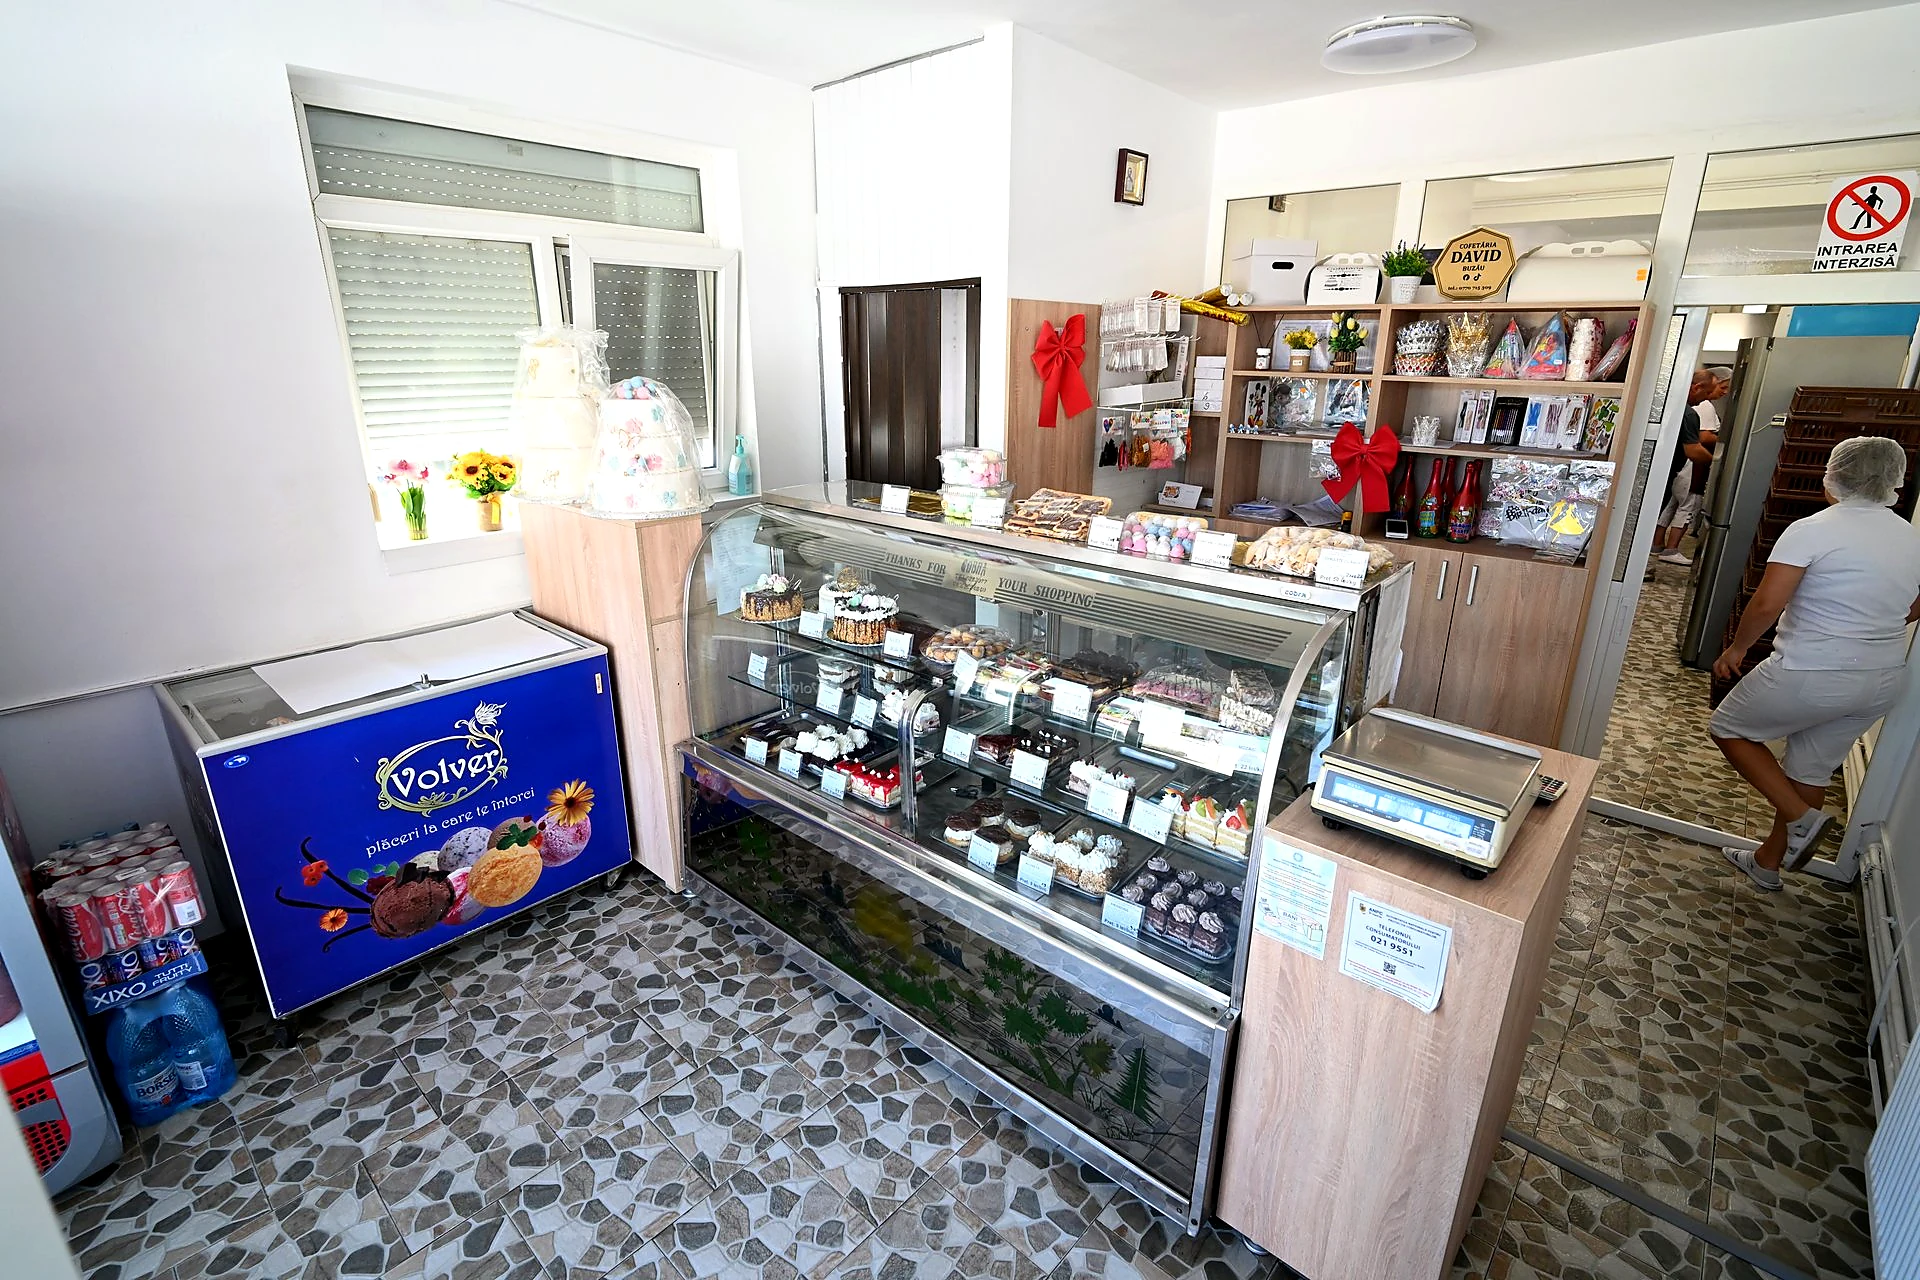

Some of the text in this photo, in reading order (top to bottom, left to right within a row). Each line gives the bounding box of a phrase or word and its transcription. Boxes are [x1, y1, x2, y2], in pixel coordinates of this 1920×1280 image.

[1450, 249, 1502, 264] DAVID
[1817, 242, 1898, 257] INTRAREA
[1813, 254, 1895, 270] INTERZISĂ
[884, 551, 946, 575] THANKS FOR
[998, 577, 1027, 593] YOUR
[1033, 585, 1096, 608] SHOPPING
[391, 749, 499, 798] Volver
[365, 787, 535, 858] plăceri la care te întorci
[1365, 925, 1421, 950] CONSUMATORULUI
[1378, 923, 1412, 941] TELEFONUL
[1370, 935, 1387, 947] 021
[1390, 942, 1413, 957] 9551
[152, 966, 193, 987] FRUITY
[154, 962, 188, 979] TUTTI
[92, 982, 147, 1009] XIXO
